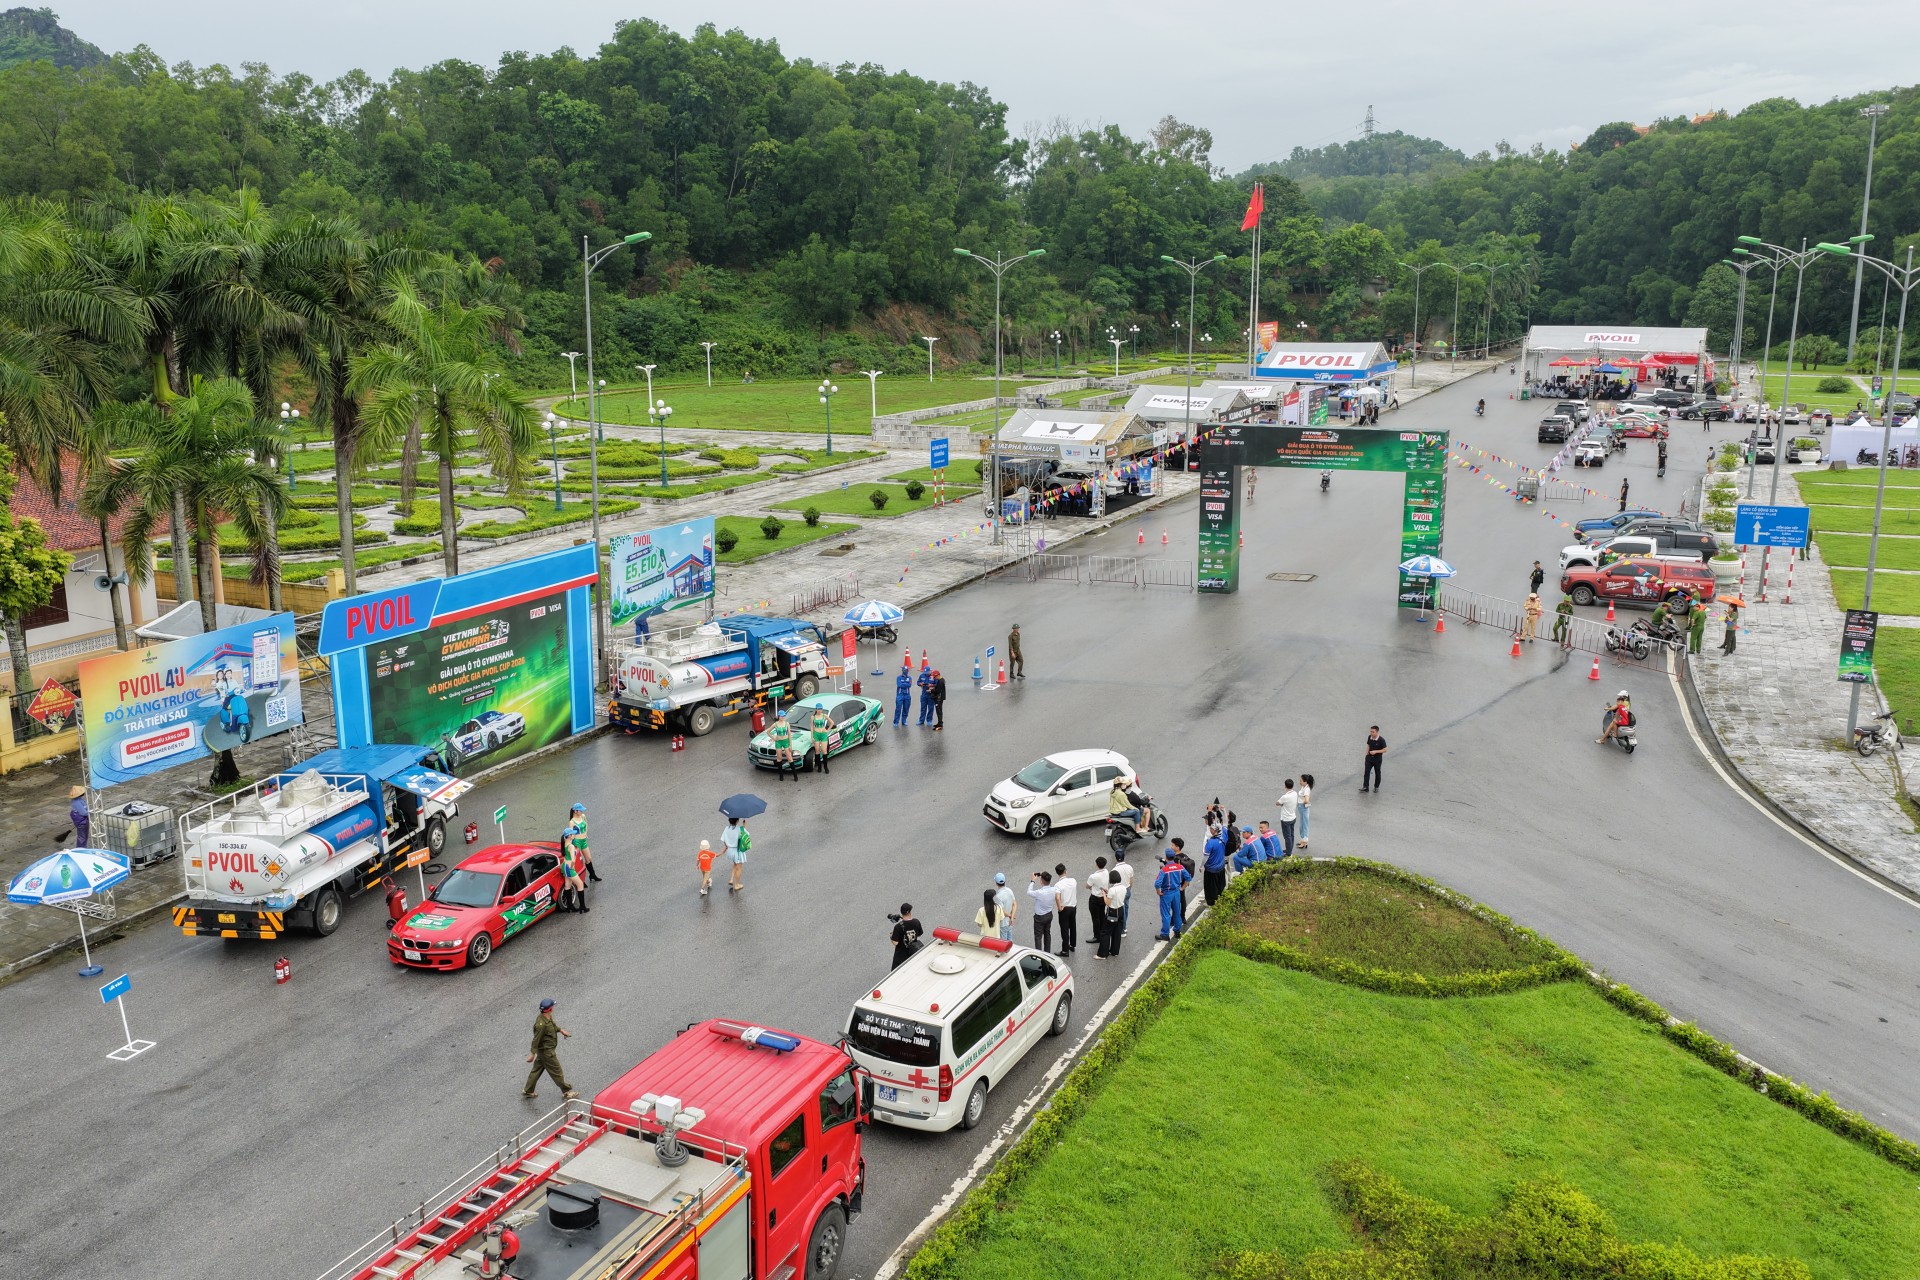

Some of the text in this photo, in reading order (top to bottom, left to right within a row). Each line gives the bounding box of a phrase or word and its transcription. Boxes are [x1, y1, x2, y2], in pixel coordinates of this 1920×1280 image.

[1588, 335, 1636, 343] PVOIL
[1278, 355, 1355, 367] PVOIL
[634, 534, 651, 547] PVOIL
[531, 607, 545, 618] PVOIL
[548, 603, 562, 613] VISA
[347, 594, 415, 640] PVOIL
[443, 627, 479, 644] VIETNAM
[442, 633, 490, 655] GYMKHANA
[442, 647, 476, 661] CHAMPIONSHIP
[440, 650, 514, 679] GIẢI ĐUA Ô TÔ GYMKHANA
[428, 657, 525, 694] VÕ ĐỊCH QUỐC GIA PVOIL CUP 2026
[630, 666, 656, 684] PVOIL
[104, 688, 202, 723] ĐỔ XĂNG TRƯỚC
[124, 708, 188, 733] TRẢ TIỀN SAU
[829, 733, 839, 743] PVOIL
[846, 726, 854, 734] VISA
[336, 818, 374, 843] PVOIL Mobile
[208, 852, 258, 873] PVOIL
[94, 868, 119, 882] PETROVIETNAM
[536, 885, 550, 901] PVOIL
[513, 903, 527, 916] VISA
[866, 1014, 874, 1022] SỞ
[881, 1017, 889, 1026] TẾ
[912, 1025, 926, 1035] ÓA
[858, 1022, 870, 1032] BỆNH
[870, 1026, 881, 1036] VIỆN
[881, 1028, 888, 1037] ĐA
[913, 1036, 930, 1047] THÀNH
[978, 1044, 986, 1056] KHOA
